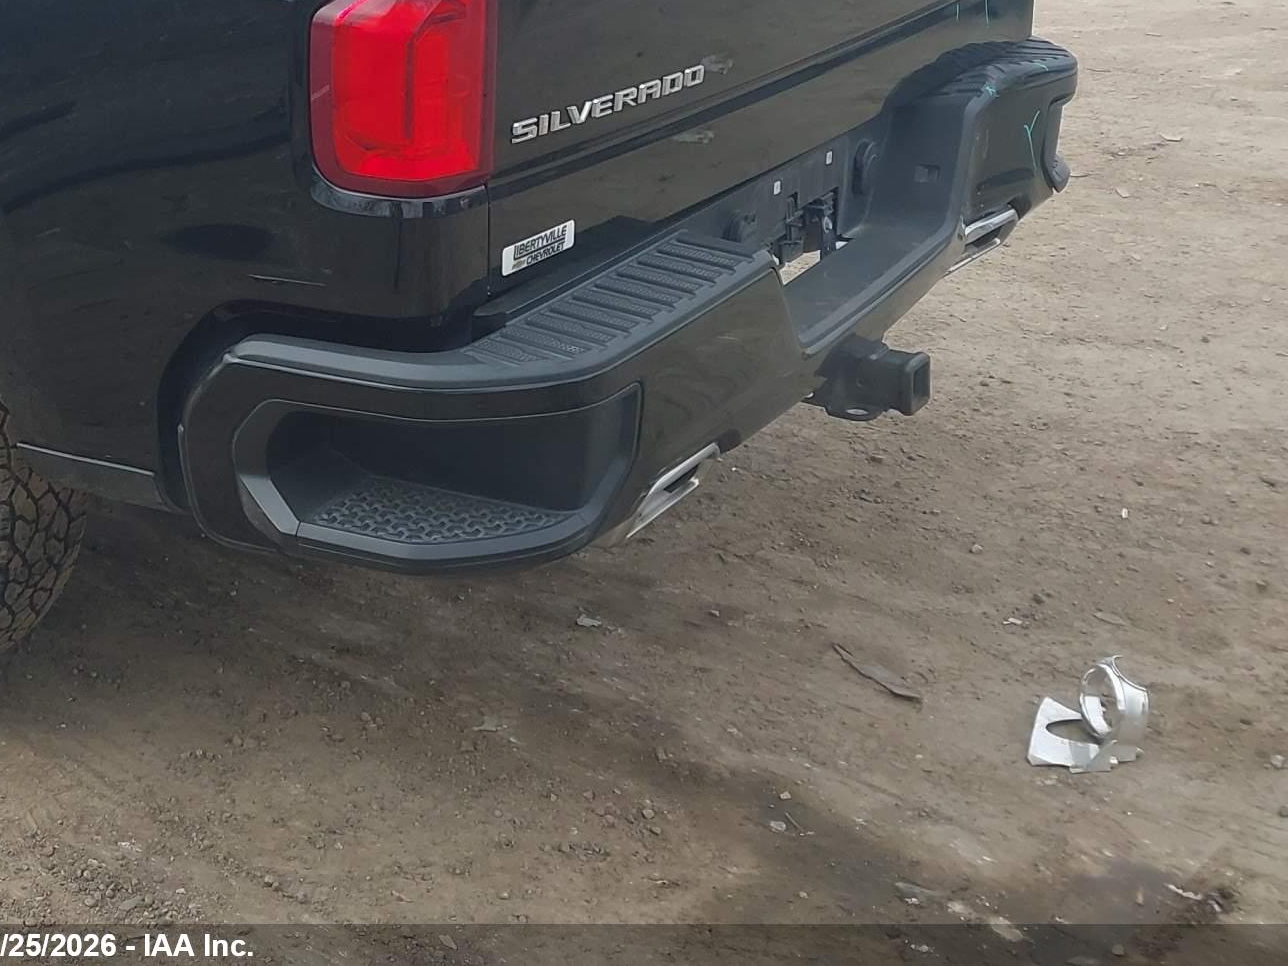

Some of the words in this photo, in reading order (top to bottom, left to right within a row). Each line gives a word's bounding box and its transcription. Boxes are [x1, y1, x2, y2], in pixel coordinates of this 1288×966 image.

[511, 64, 705, 144] SILVERADO
[513, 224, 568, 260] LIBERTYVILLE
[526, 242, 566, 265] CHEVROLET
